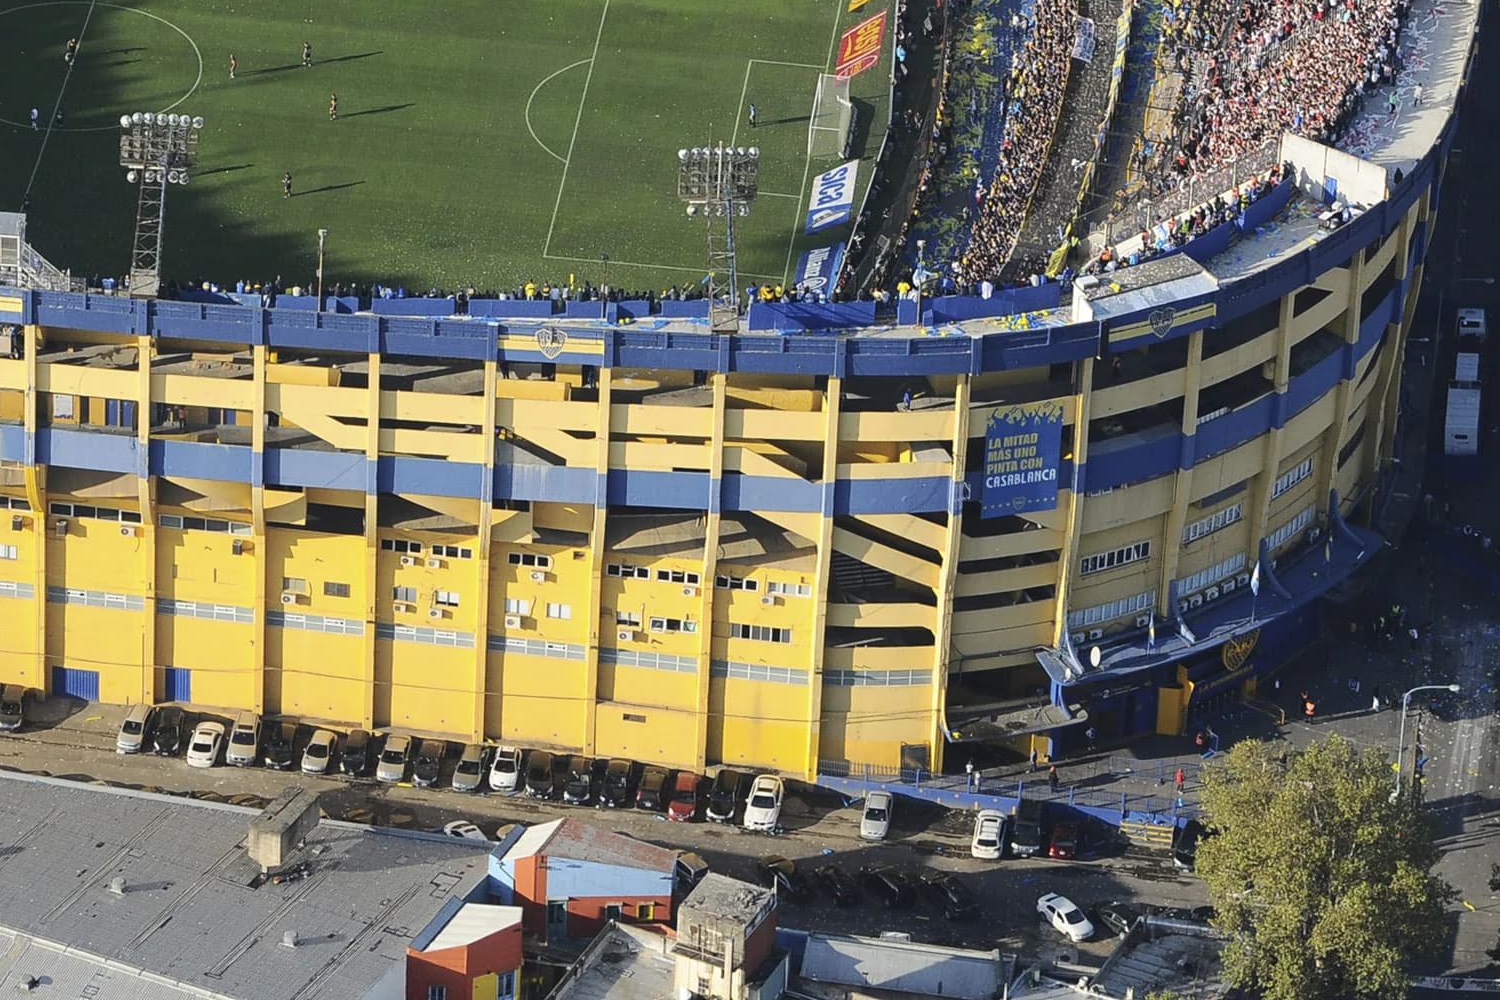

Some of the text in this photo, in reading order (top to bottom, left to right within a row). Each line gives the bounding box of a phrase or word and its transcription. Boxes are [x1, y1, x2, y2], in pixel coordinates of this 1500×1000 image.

[988, 433, 1038, 449] LA MITAD
[988, 446, 1036, 462] MAS UNO
[987, 457, 1043, 475] PINTA CON
[986, 468, 1056, 488] CASABLANCA
